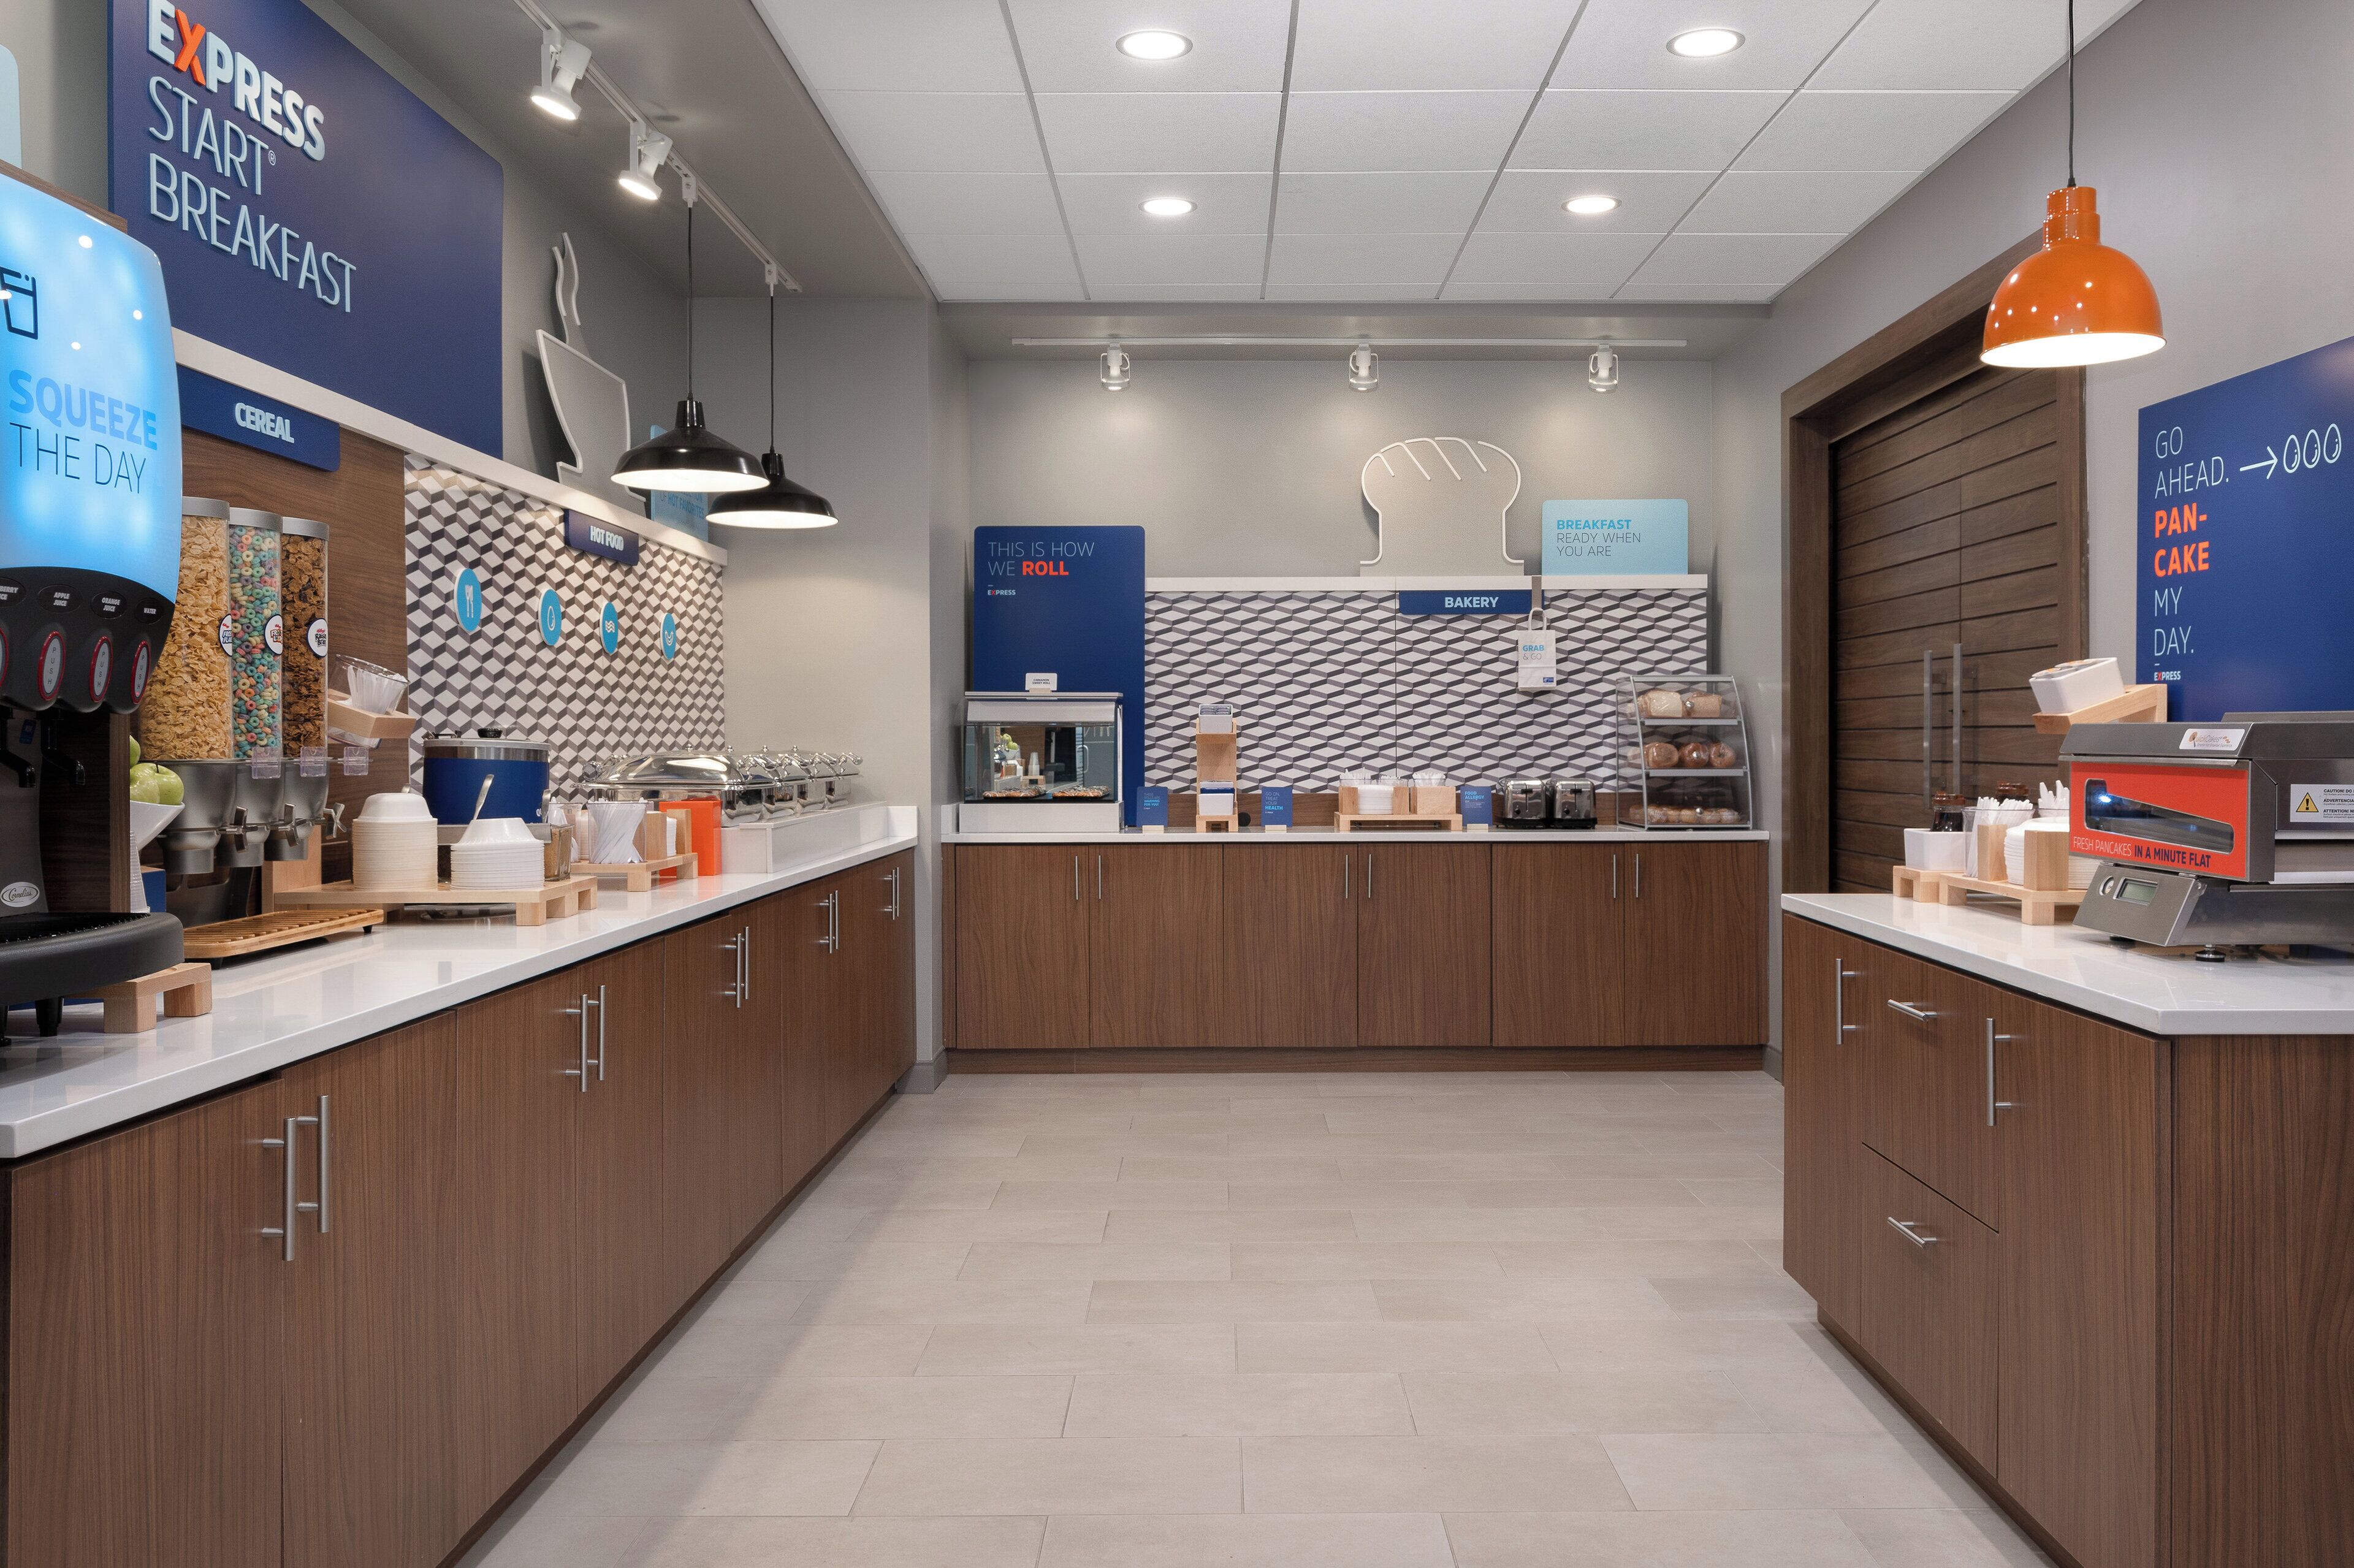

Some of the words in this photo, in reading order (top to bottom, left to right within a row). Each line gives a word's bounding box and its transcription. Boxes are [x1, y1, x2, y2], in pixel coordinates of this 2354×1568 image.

[148, 0, 325, 161] EXPRESS
[150, 153, 357, 313] BREAKFAST
[9, 369, 158, 451] SQUEEZE
[234, 402, 295, 444] CEREAL
[9, 422, 80, 480] THE
[94, 443, 147, 494] DAY
[2155, 426, 2184, 459] GO
[2154, 456, 2230, 500] AHEAD.
[1557, 519, 1632, 530] BREAKFAST
[2154, 502, 2207, 539] PAN-
[590, 525, 605, 545] HOT
[606, 531, 624, 551] FOOD
[988, 542, 1024, 557] THIS
[1032, 542, 1045, 557] IS
[1052, 542, 1095, 557] HOW
[1556, 546, 1583, 557] YOU
[1587, 546, 1611, 557] ARE
[1557, 533, 1598, 543] READY
[1602, 533, 1641, 543] WHEN
[988, 561, 1015, 576] WE
[1022, 561, 1069, 576] ROLL
[2154, 541, 2210, 577] CAKE
[1445, 597, 1499, 608] BAKERY
[2154, 586, 2182, 617] MY
[2154, 625, 2194, 657] DAY.
[48, 647, 56, 685] PUSH
[97, 651, 105, 687] PUSH
[136, 655, 145, 689] PUSH
[2154, 671, 2181, 681] EXPRESS
[2073, 836, 2094, 851] FRESH
[2095, 839, 2131, 857] PANCAKES
[2135, 845, 2143, 858] IN
[2145, 847, 2151, 859] A
[2154, 847, 2186, 864] MINUTE
[2189, 853, 2211, 868] FLAT
